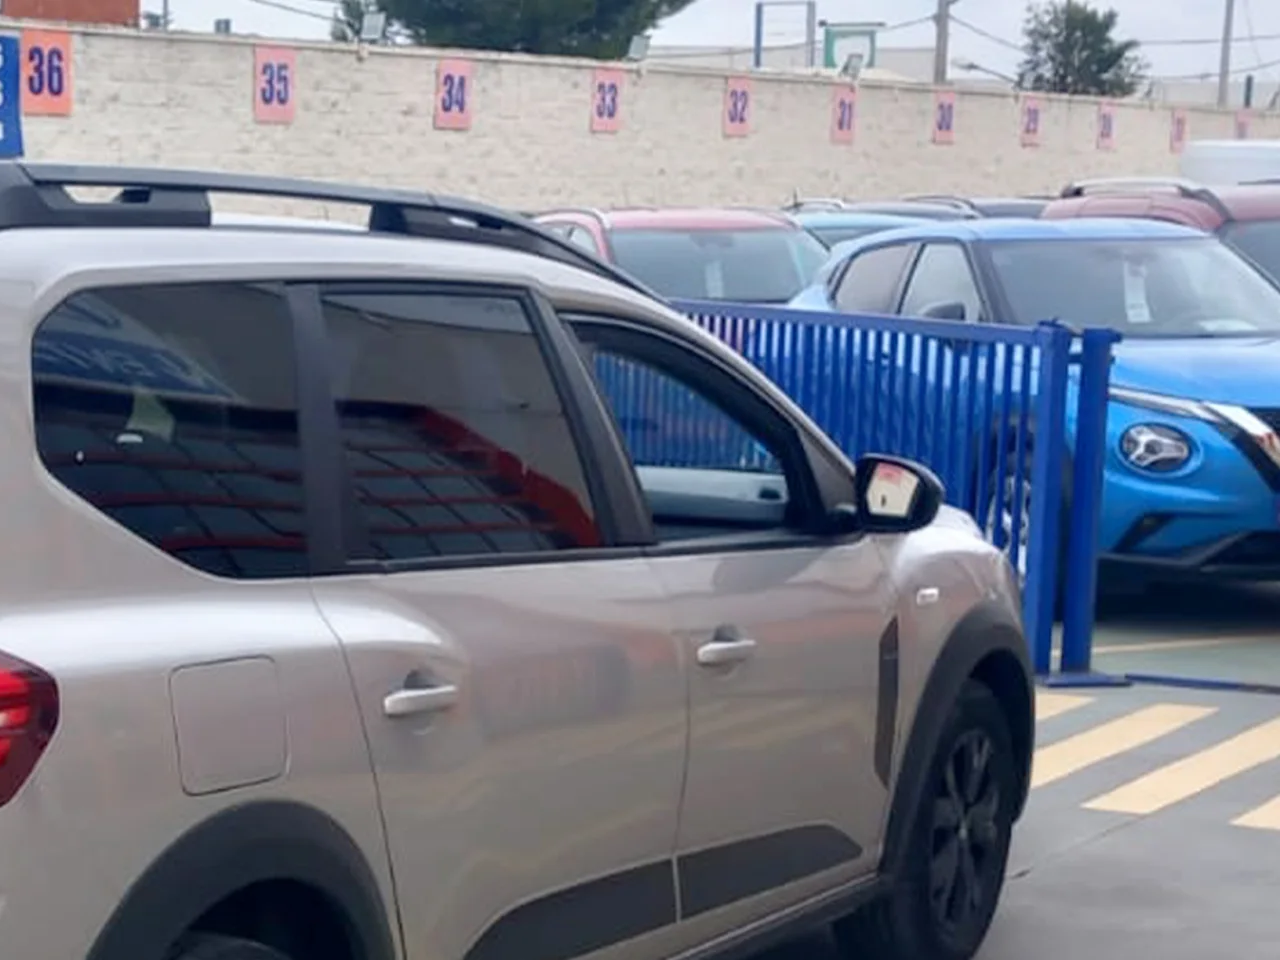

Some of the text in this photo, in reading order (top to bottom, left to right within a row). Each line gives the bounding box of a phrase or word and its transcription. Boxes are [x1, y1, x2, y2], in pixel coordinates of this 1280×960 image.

[28, 46, 64, 96] 36
[261, 63, 290, 105] 35
[441, 74, 466, 113] 34
[596, 82, 618, 119] 33
[728, 89, 749, 124] 32
